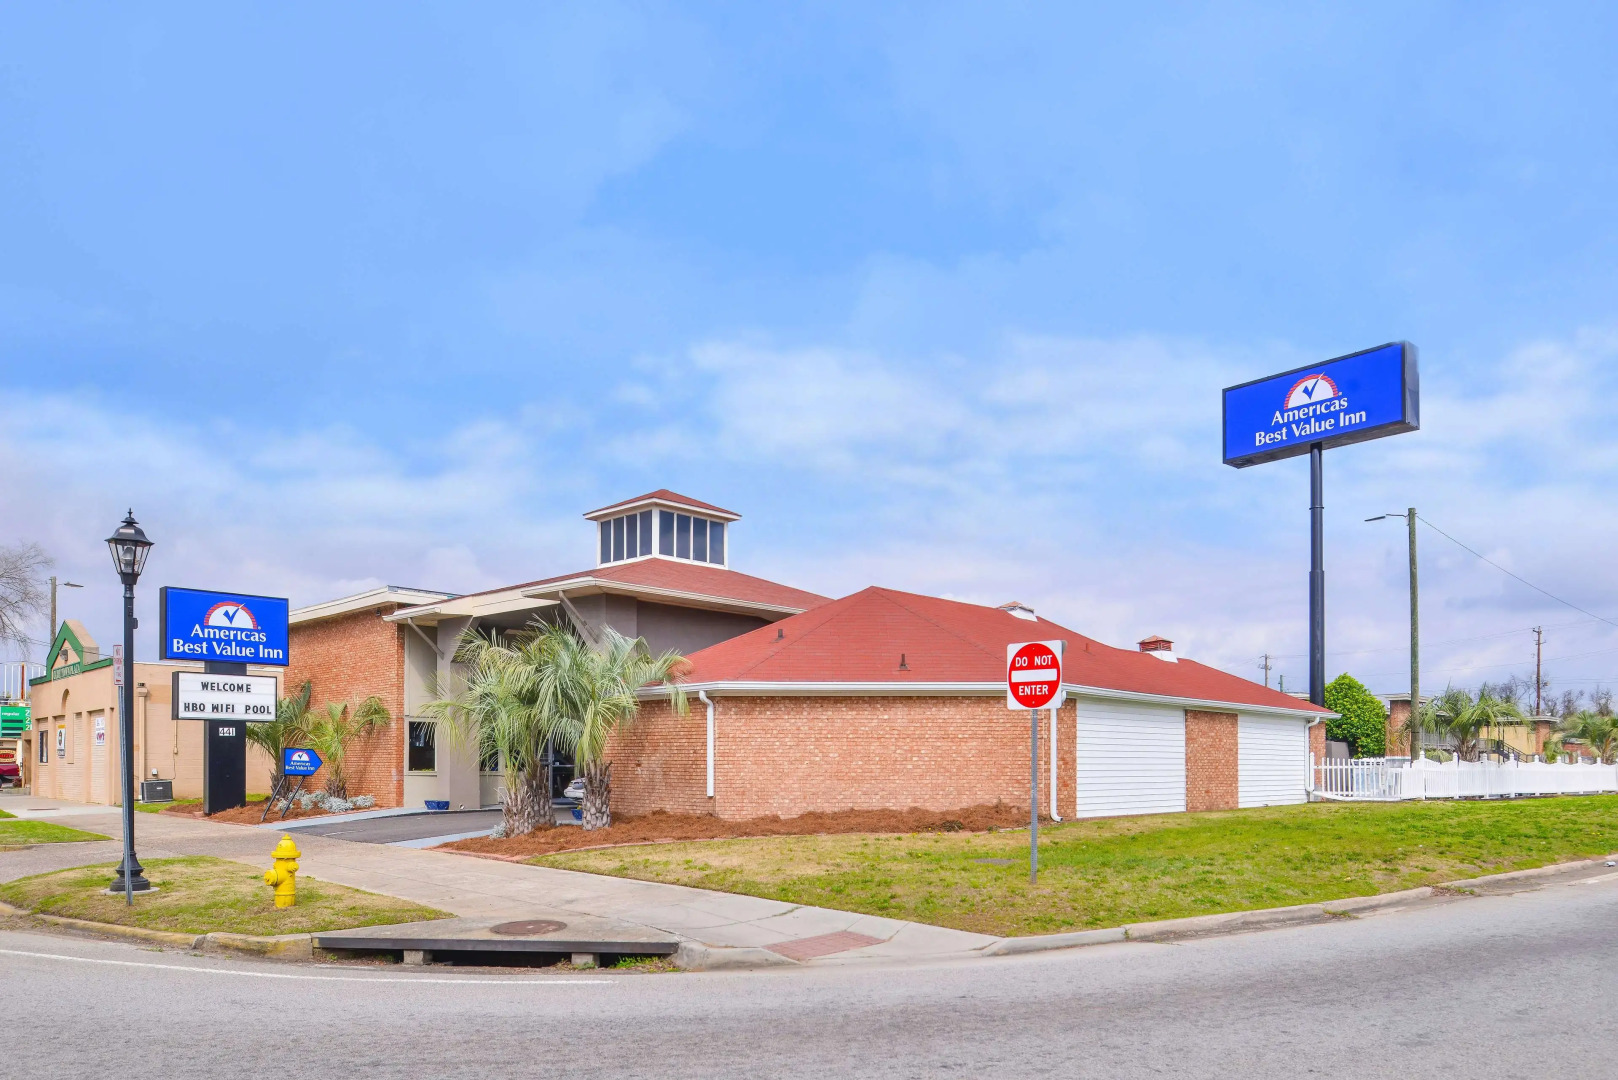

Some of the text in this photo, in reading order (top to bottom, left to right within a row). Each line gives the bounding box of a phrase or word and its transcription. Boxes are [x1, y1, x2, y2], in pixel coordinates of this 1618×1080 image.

[1271, 397, 1348, 426] Americas
[1255, 410, 1367, 447] Best Value Inn
[190, 623, 267, 643] Americas
[172, 638, 283, 659] Best Value Inn
[1015, 655, 1052, 667] DO NOT
[201, 681, 251, 693] WELCOME
[1019, 685, 1048, 695] ENTER
[183, 702, 272, 715] HBO WIFI POOL
[219, 727, 235, 736] 441
